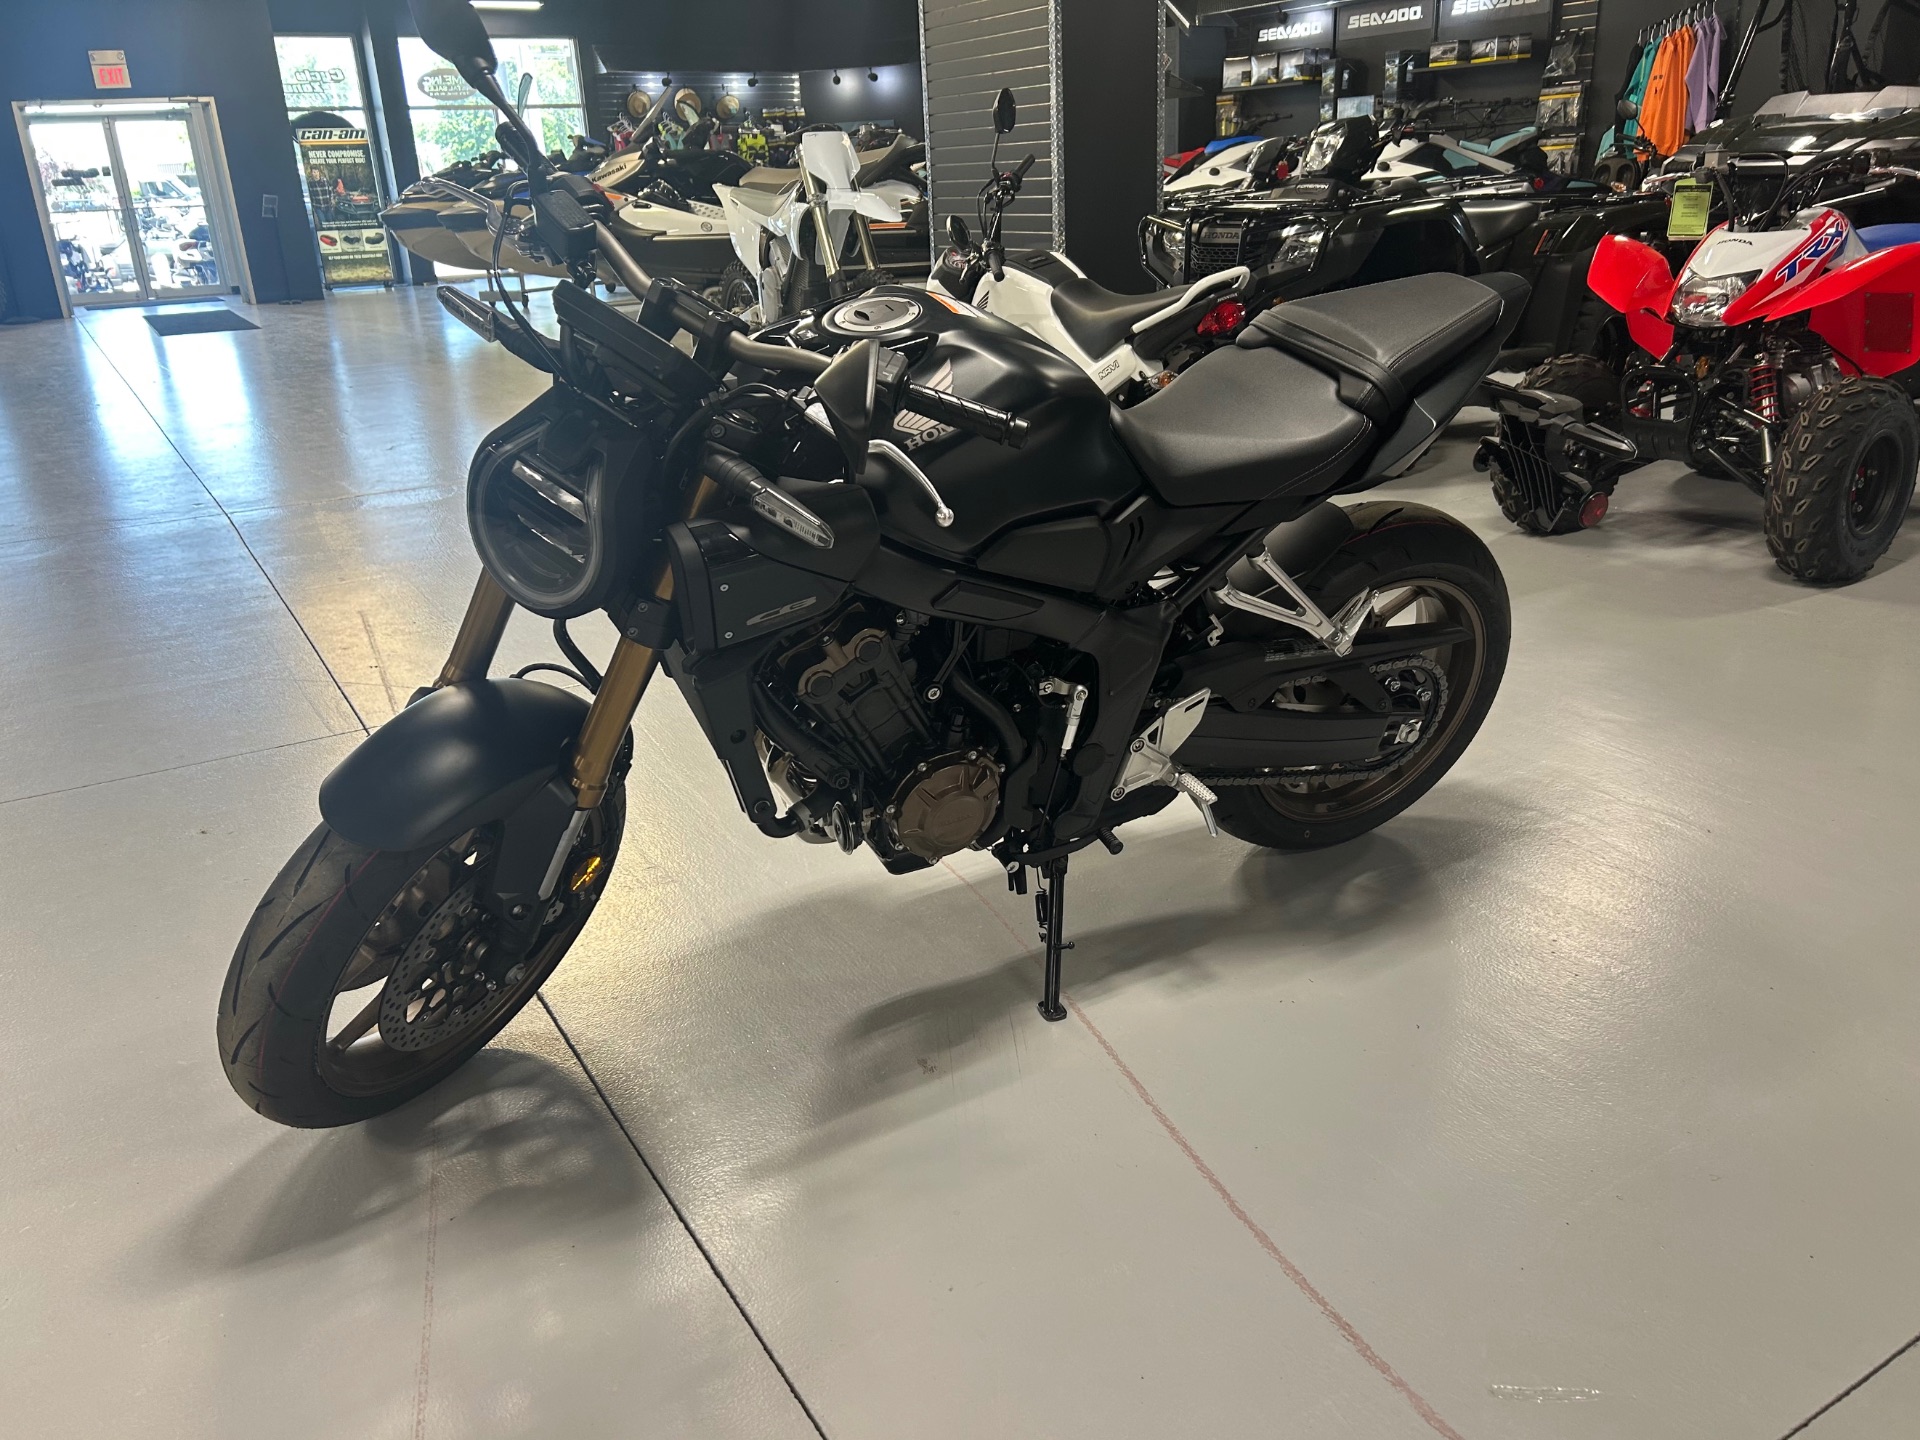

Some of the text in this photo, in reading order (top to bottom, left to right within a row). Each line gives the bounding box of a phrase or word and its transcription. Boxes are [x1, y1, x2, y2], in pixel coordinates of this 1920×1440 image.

[98, 67, 124, 86] EXIT
[300, 129, 366, 140] can-am
[308, 149, 366, 158] NEVER COMPROMISE.
[591, 162, 627, 183] Kawasaki
[1203, 231, 1240, 240] HONDA
[1716, 237, 1753, 247] HONDA
[1774, 219, 1845, 285] TRX
[1098, 359, 1120, 380] NAVI
